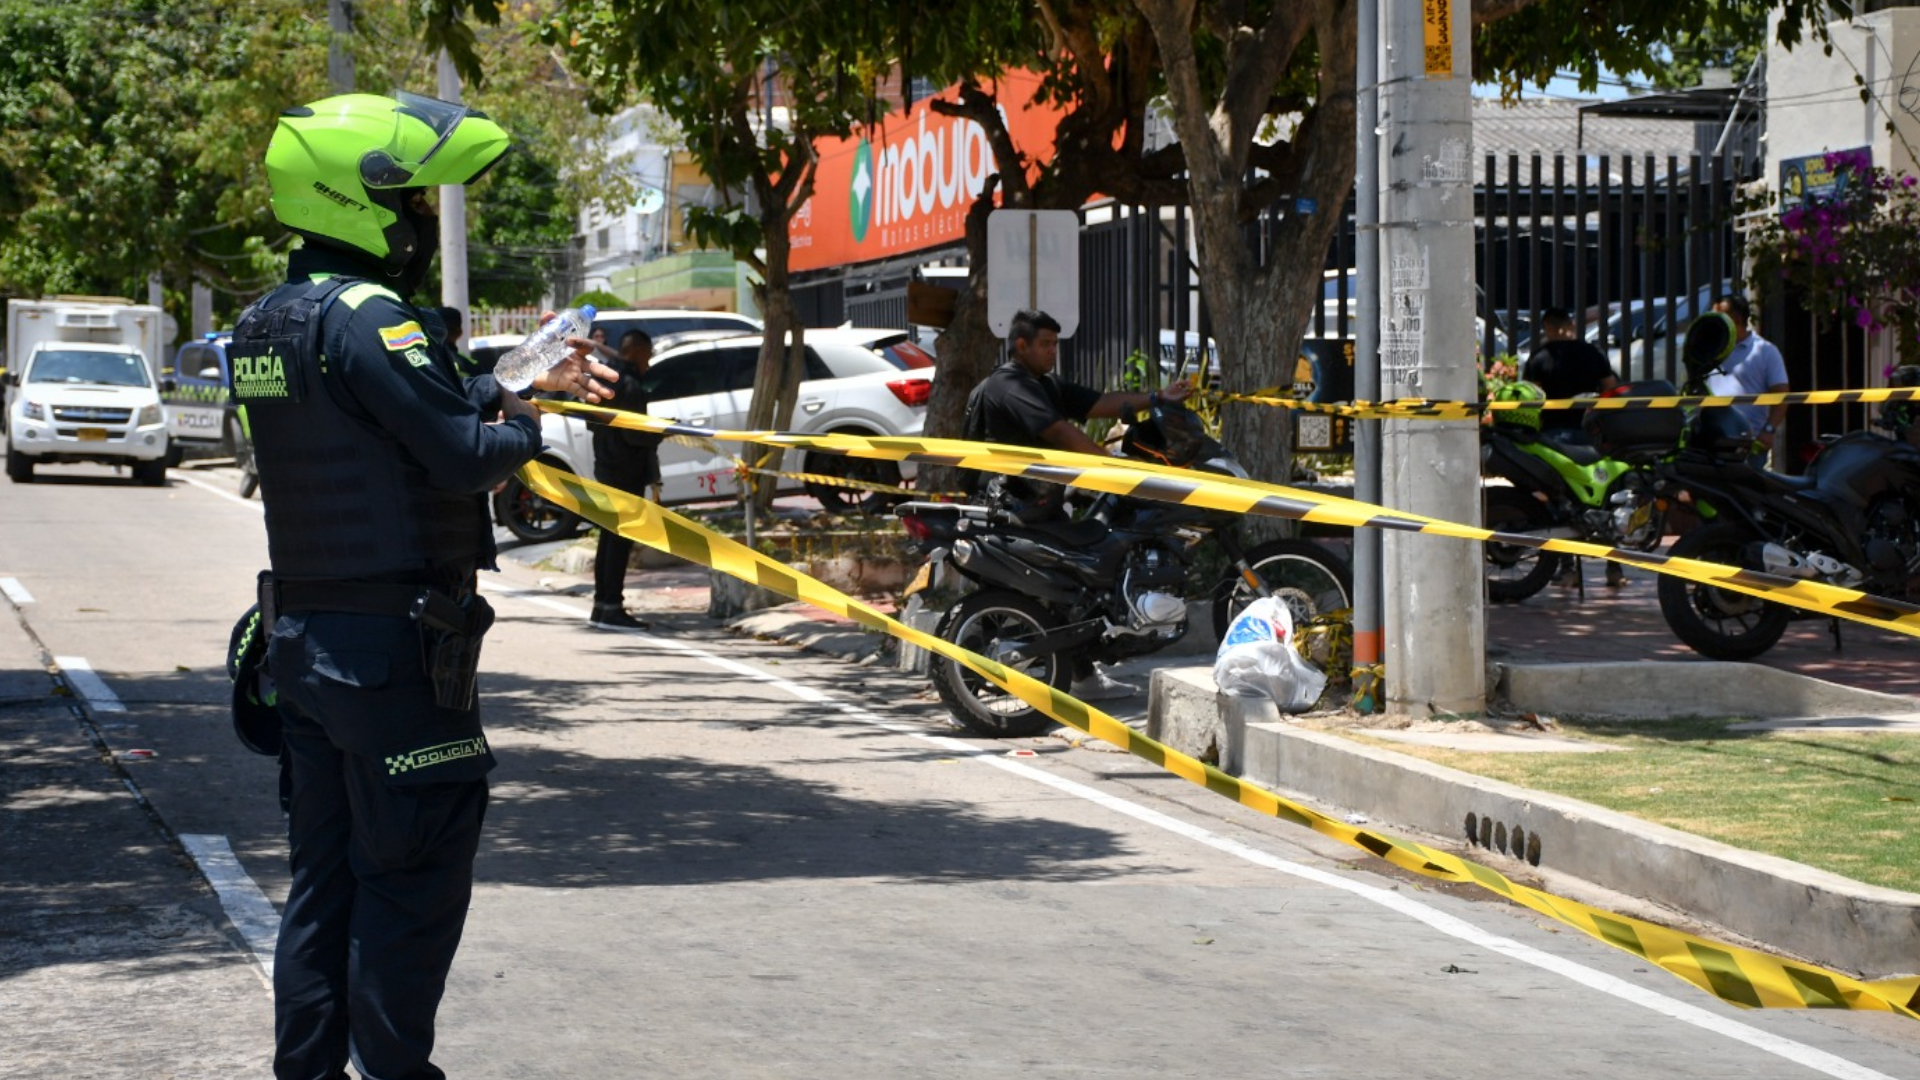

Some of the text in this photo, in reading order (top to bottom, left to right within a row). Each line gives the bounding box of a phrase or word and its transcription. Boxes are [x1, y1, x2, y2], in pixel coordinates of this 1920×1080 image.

[313, 181, 368, 212] SHAFT
[233, 346, 286, 382] POLICÍA
[417, 744, 472, 763] POLICÍA
